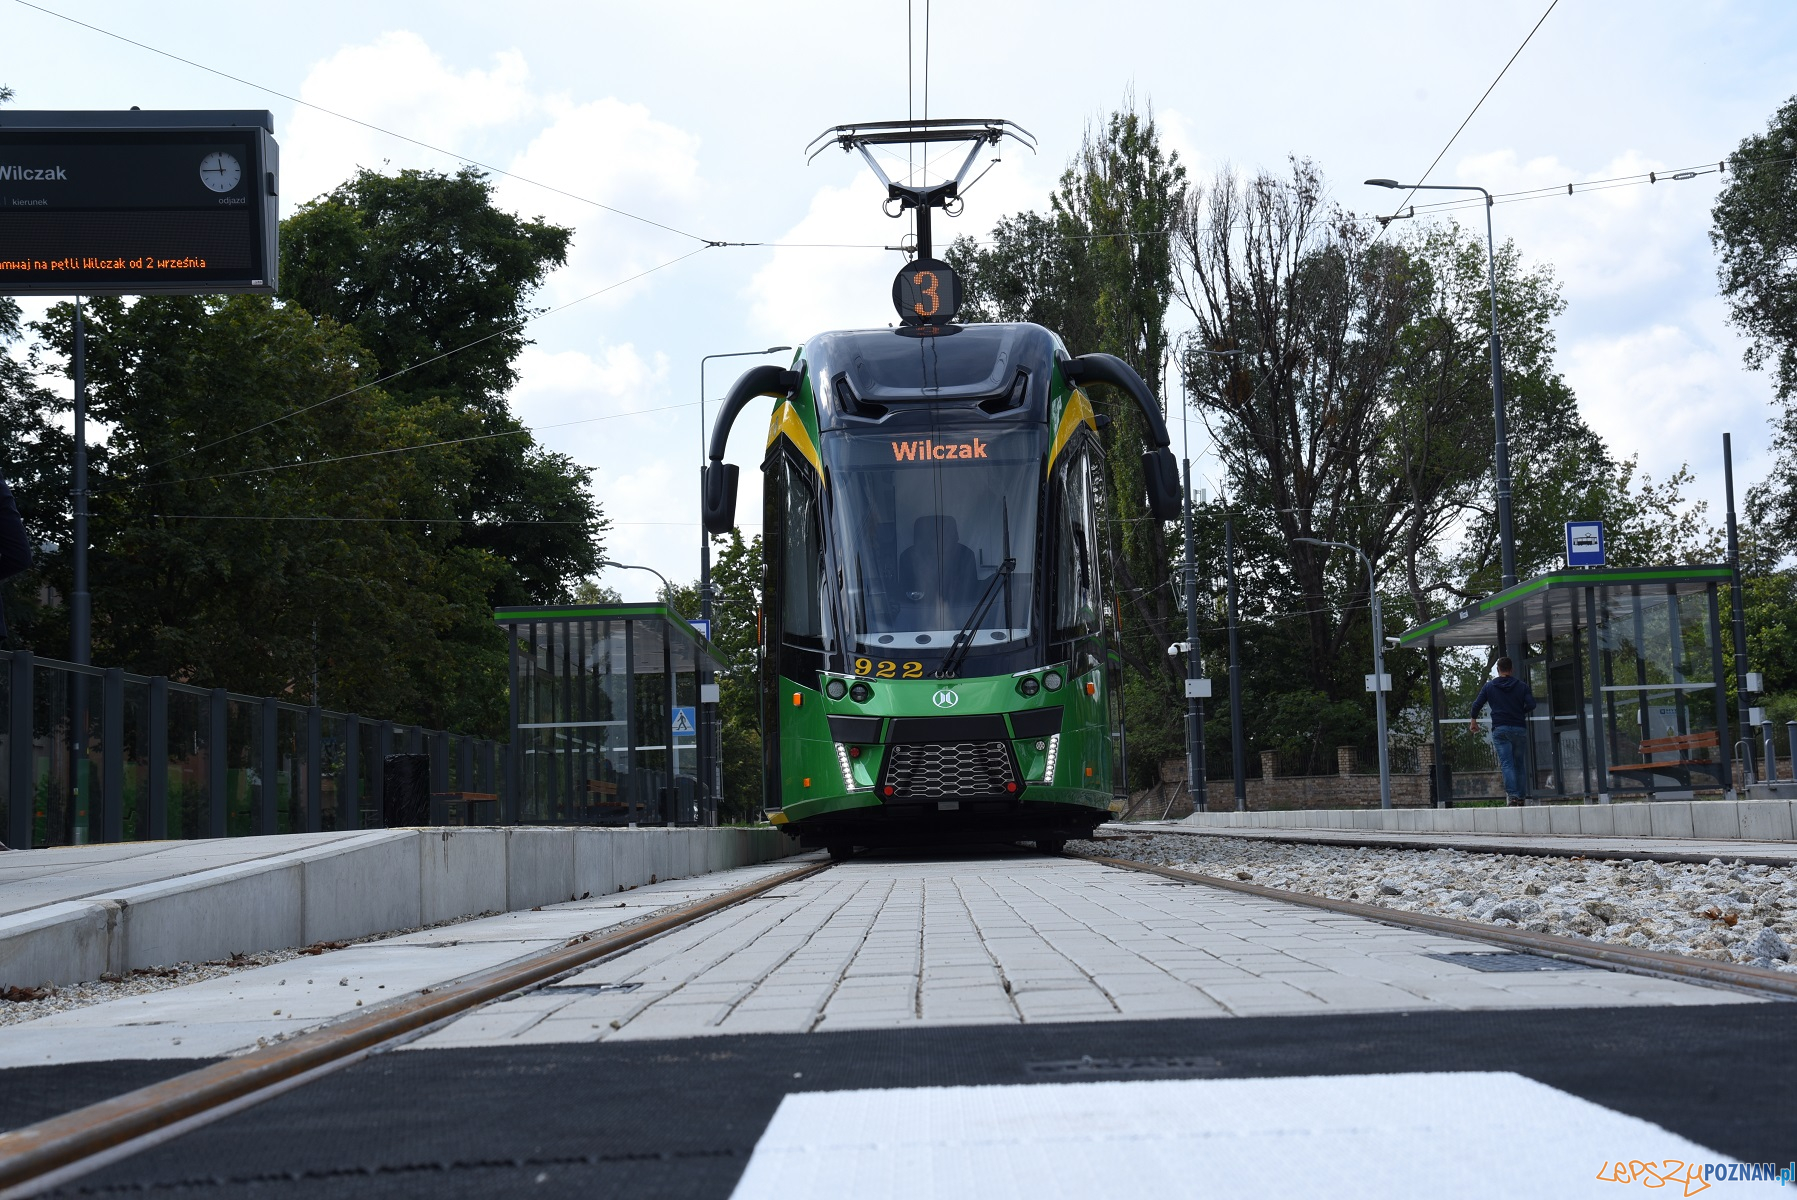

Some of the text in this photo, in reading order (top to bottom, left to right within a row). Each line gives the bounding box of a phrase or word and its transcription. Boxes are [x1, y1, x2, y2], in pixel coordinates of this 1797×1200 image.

[12, 198, 48, 206] kierunek
[218, 197, 246, 206] odjazd
[0, 256, 206, 271] mwaj na pętli Wilczak od 2 września
[913, 271, 939, 317] 3
[891, 437, 988, 462] Wilczak
[854, 657, 924, 679] 922
